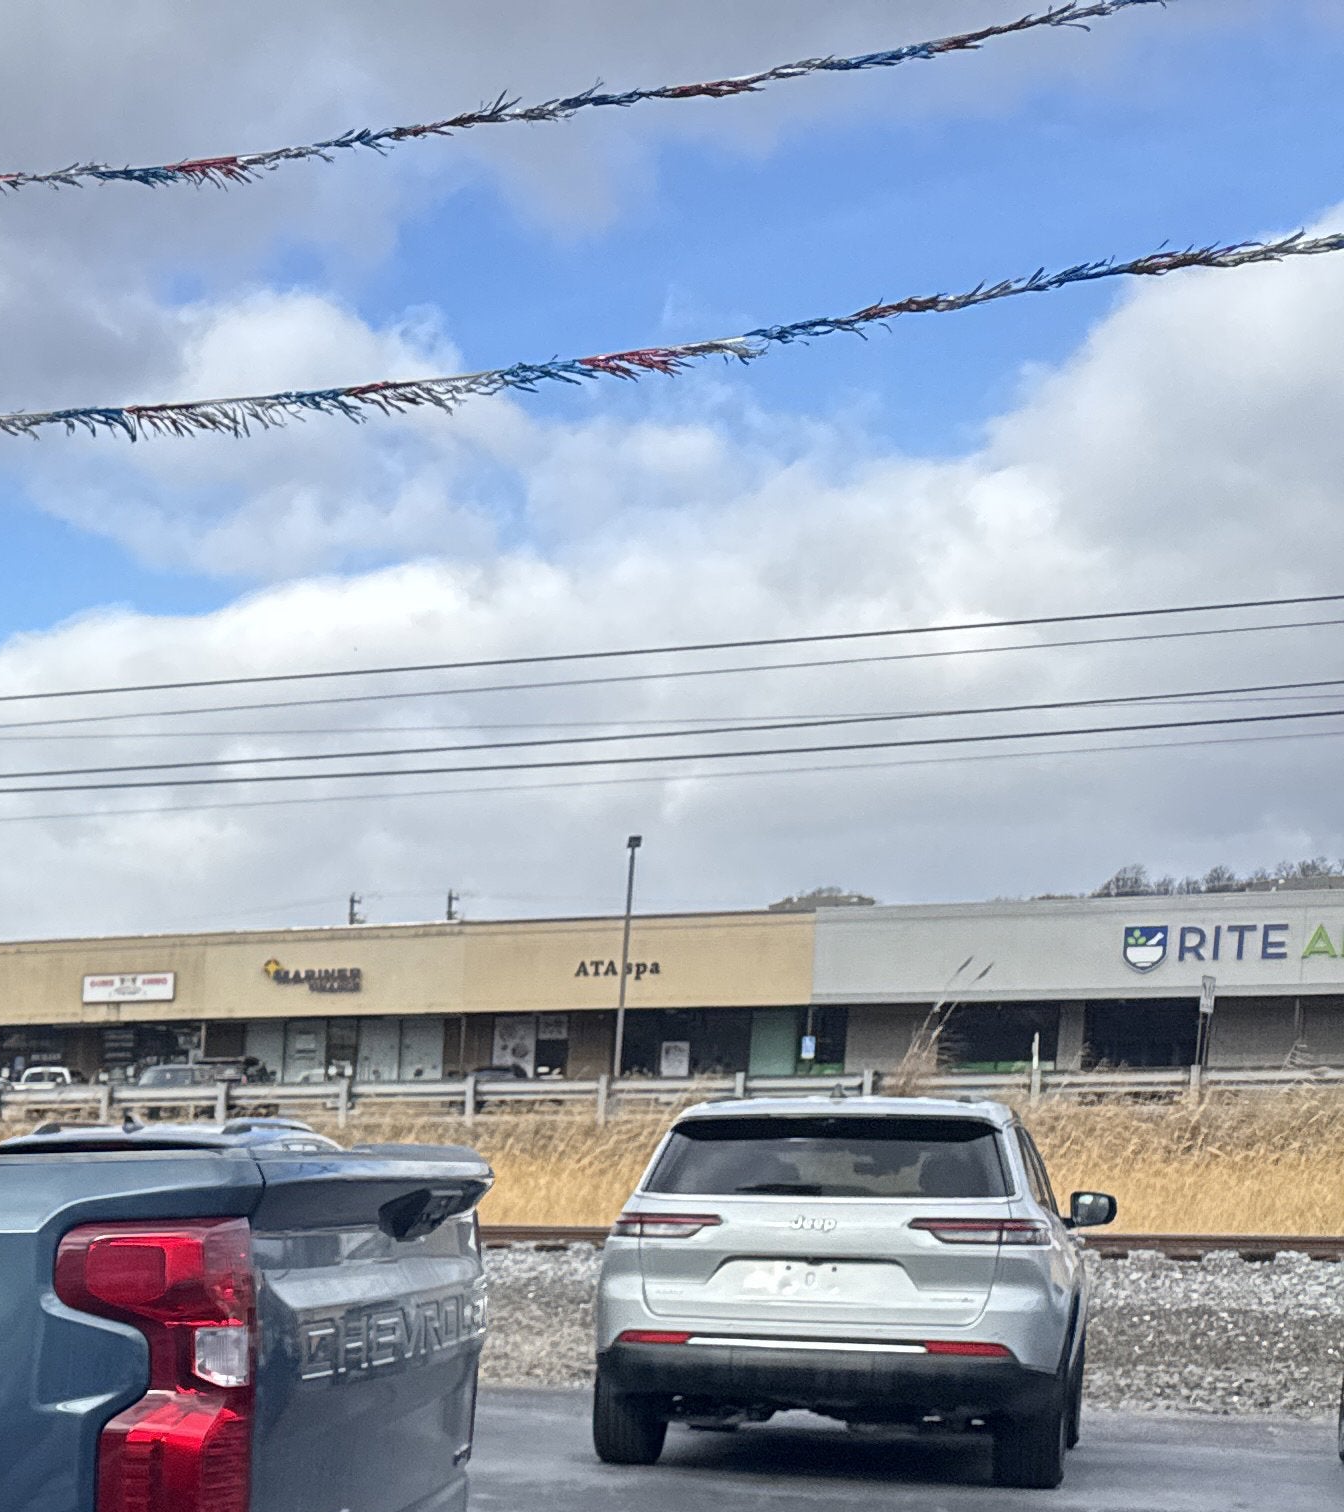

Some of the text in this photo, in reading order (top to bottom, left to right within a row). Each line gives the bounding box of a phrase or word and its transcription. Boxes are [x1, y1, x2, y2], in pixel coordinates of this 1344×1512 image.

[1178, 923, 1344, 961] RITE A
[574, 960, 660, 980] ATA spa
[791, 1215, 837, 1232] Jeep
[300, 1293, 488, 1380] CHEVROL
